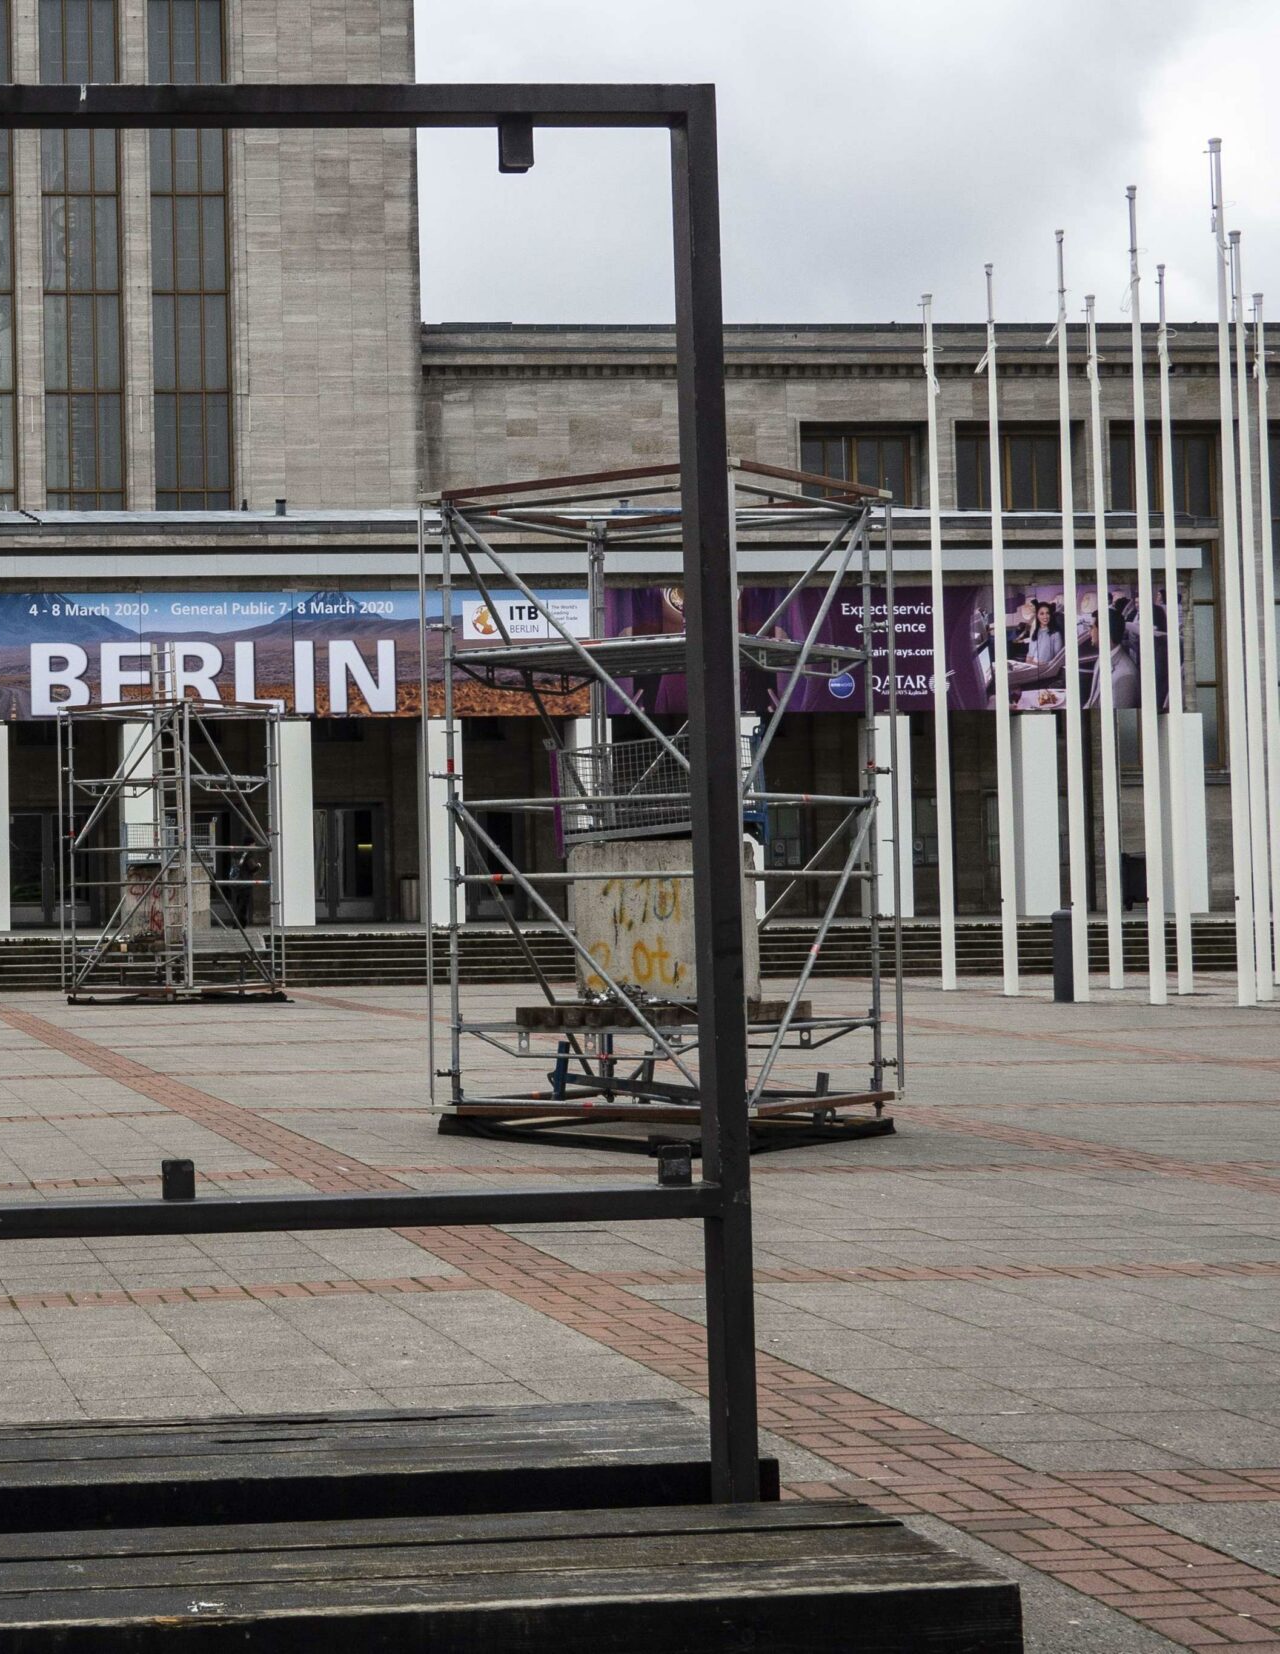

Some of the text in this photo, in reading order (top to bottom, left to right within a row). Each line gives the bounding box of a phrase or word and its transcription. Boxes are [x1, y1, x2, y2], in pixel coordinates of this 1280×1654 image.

[29, 604, 39, 617] 4
[52, 603, 61, 617] 8
[65, 602, 111, 617] March
[114, 603, 150, 616] 2020
[171, 602, 229, 616] General
[232, 601, 276, 616] Public
[297, 601, 306, 615] 8
[310, 600, 356, 615] March
[359, 601, 395, 614] 2020
[509, 605, 539, 620] ITB
[841, 603, 936, 618] Expect servic
[509, 624, 540, 633] BERLIN
[30, 640, 397, 716] BERLIN
[870, 675, 927, 692] QATAR
